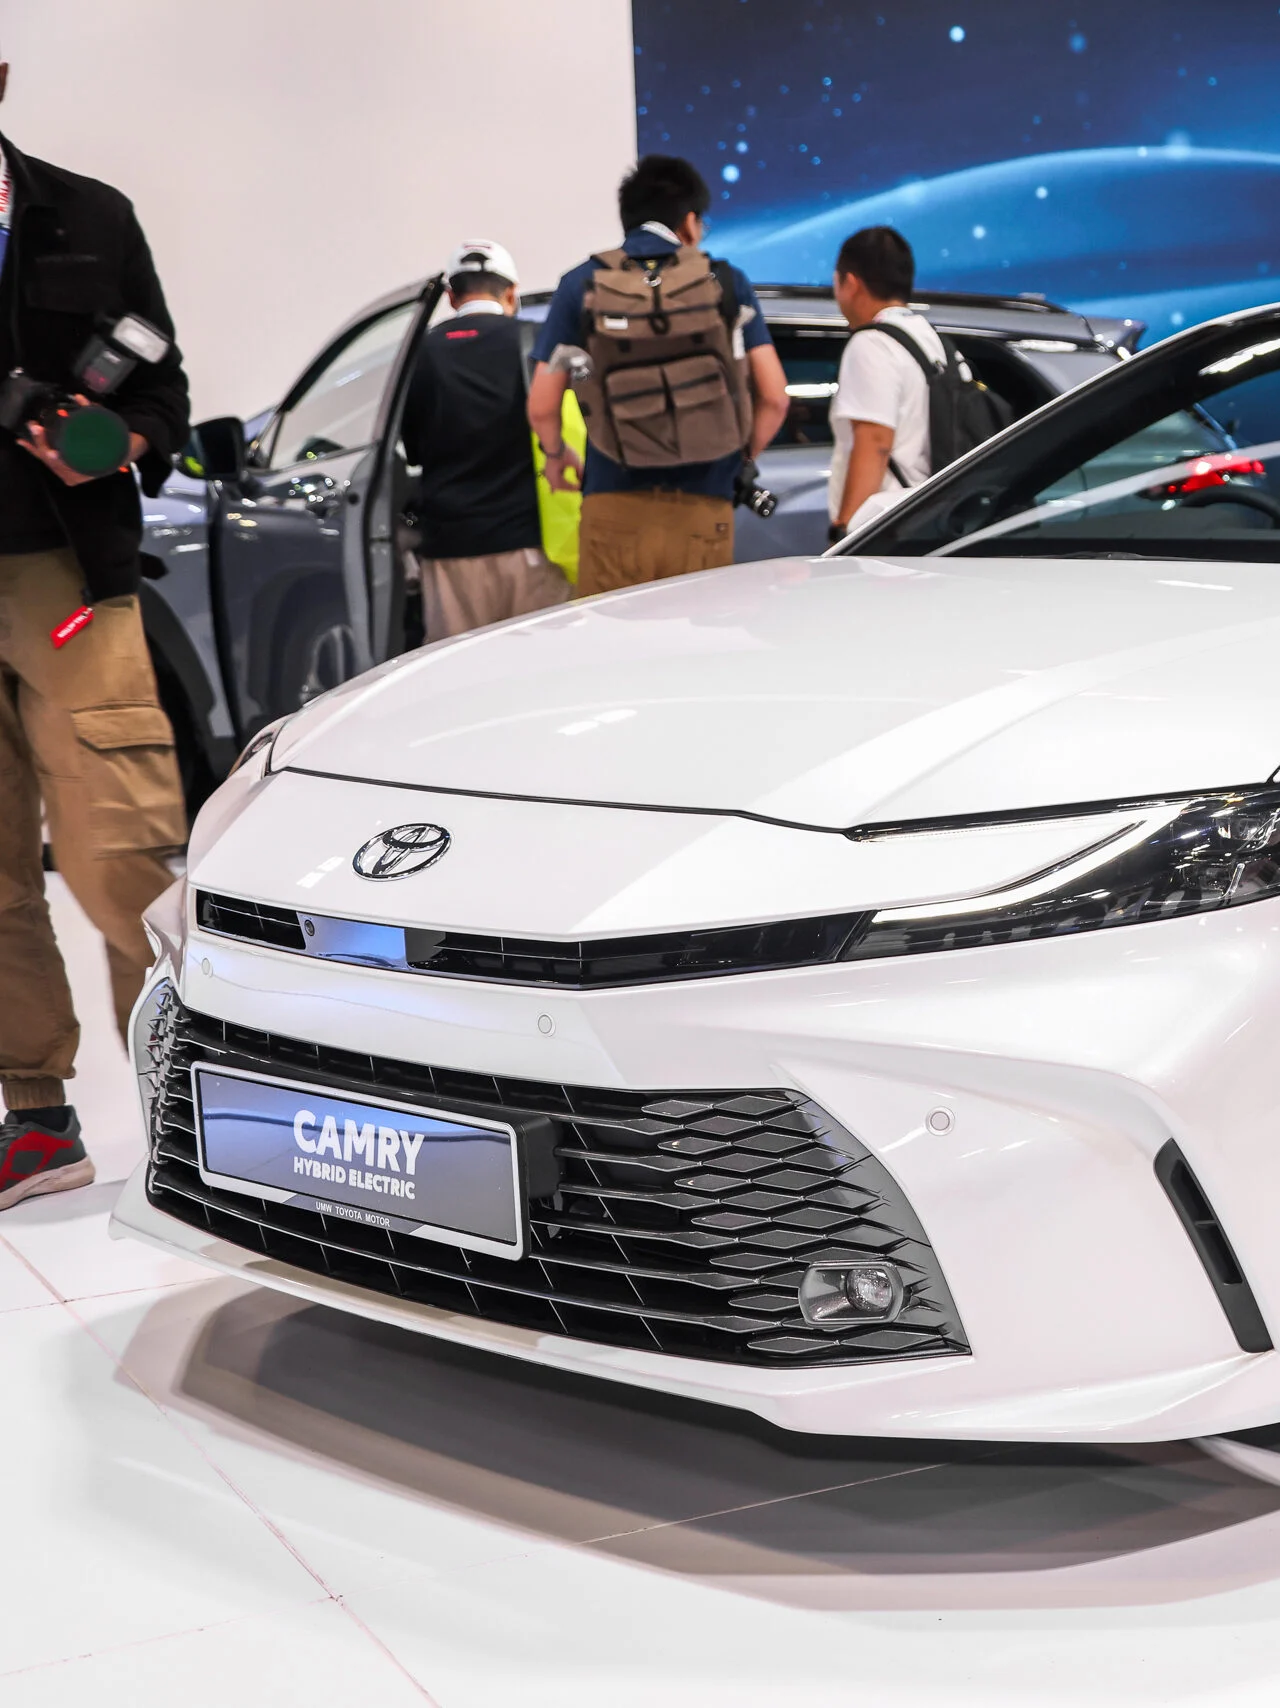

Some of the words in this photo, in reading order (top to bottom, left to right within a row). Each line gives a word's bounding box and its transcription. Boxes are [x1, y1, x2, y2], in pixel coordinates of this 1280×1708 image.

[293, 1109, 425, 1176] CAMRY
[293, 1156, 346, 1184] HYBRID
[348, 1168, 416, 1200] ELECTRIC
[315, 1201, 332, 1215] UMW
[335, 1205, 363, 1222] TOYOTA
[365, 1212, 391, 1228] MOTOR
